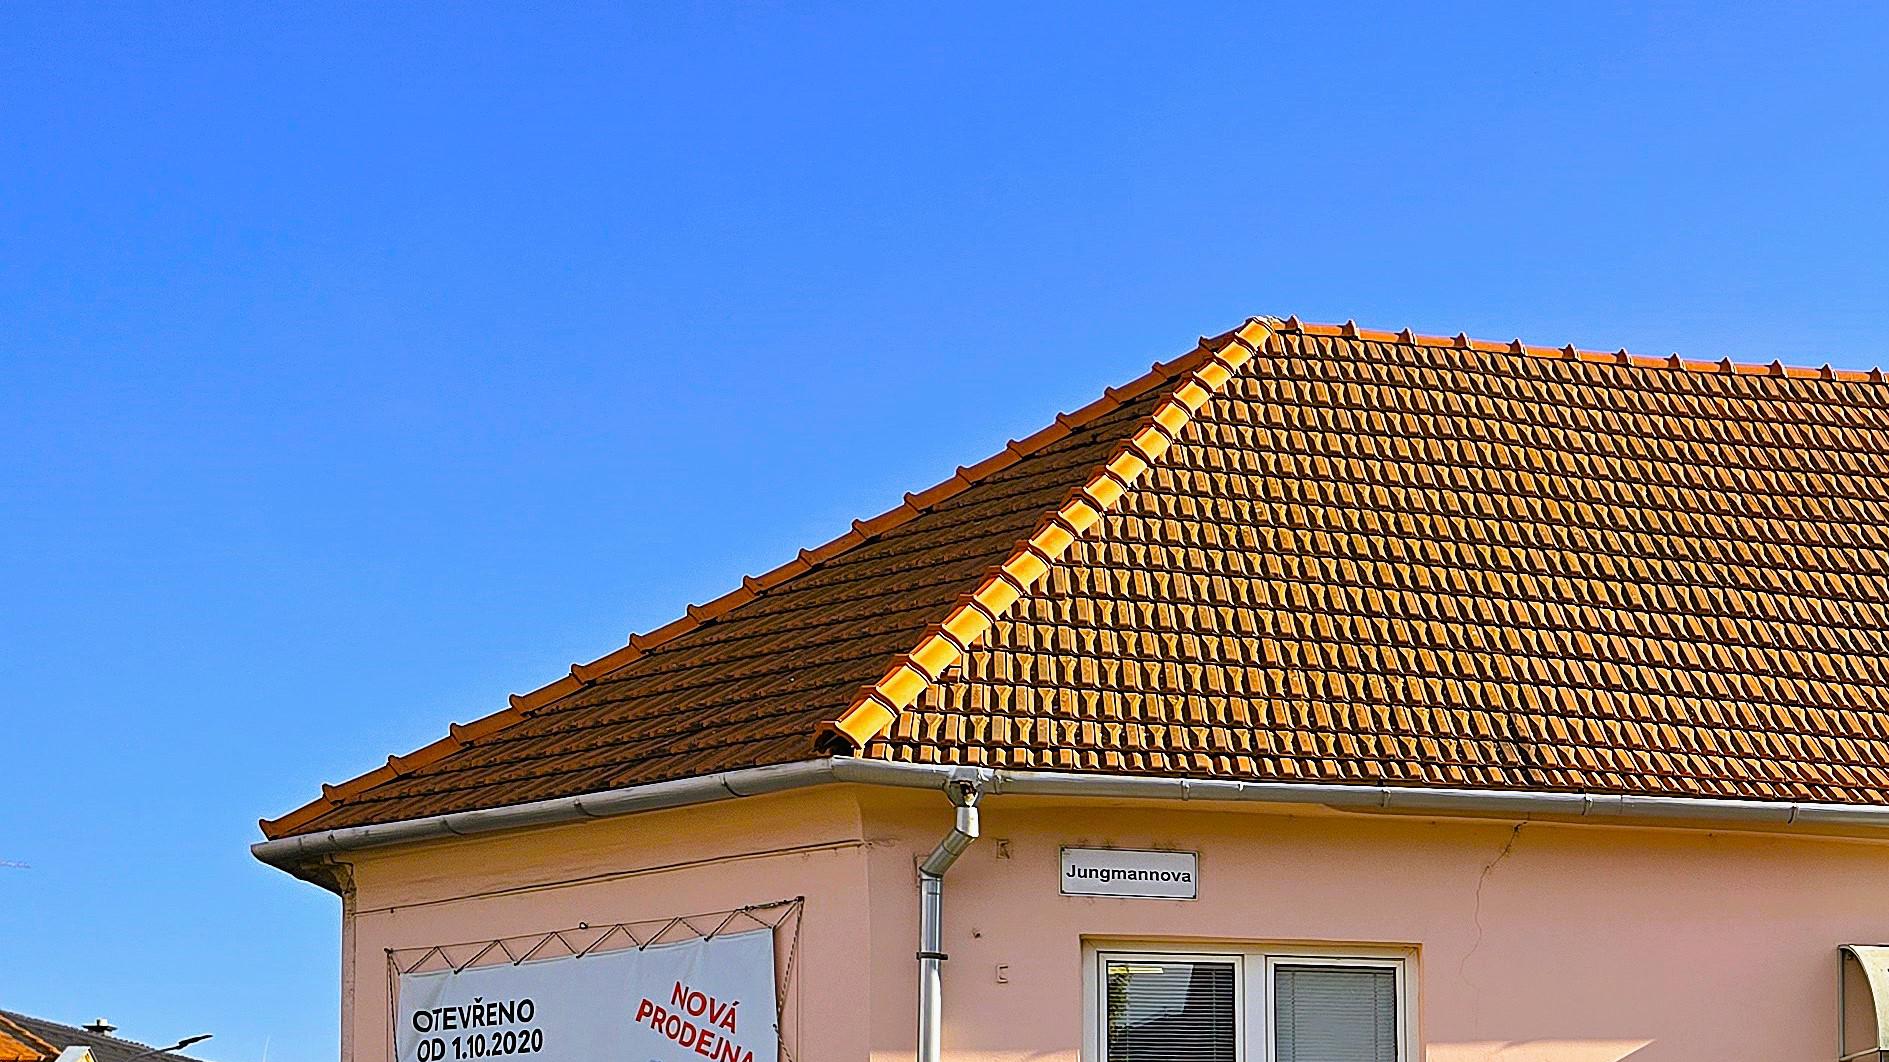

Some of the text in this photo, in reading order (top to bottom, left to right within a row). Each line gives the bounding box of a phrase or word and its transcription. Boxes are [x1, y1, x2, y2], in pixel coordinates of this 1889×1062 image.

[1066, 864, 1191, 883] Jungmannova
[413, 997, 535, 1033] OTEVŘENO
[671, 981, 740, 1034] NOVÁ
[416, 1028, 543, 1062] OD 1.10.2020
